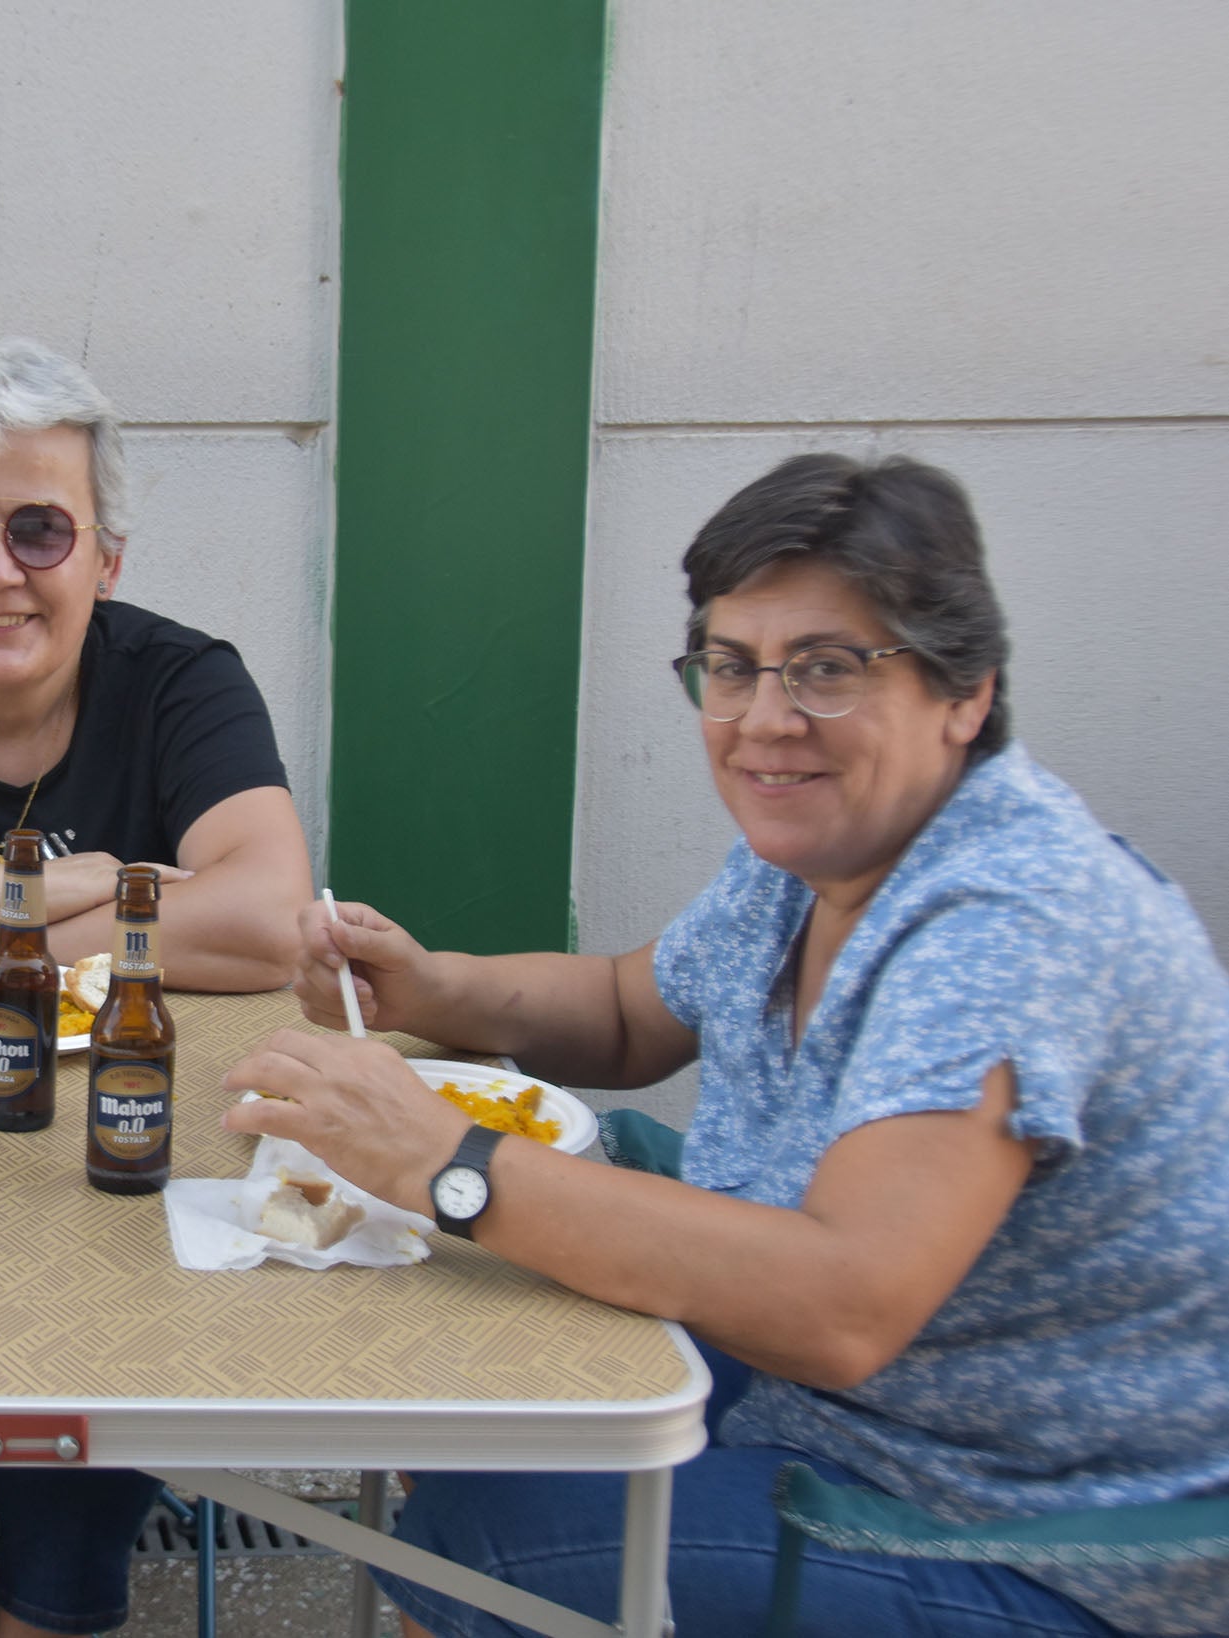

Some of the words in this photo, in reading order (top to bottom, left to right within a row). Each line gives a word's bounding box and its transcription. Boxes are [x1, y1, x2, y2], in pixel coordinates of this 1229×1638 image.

[118, 960, 155, 970] TOSTADA
[100, 1096, 163, 1116] Mahou
[113, 1135, 150, 1144] TOSTADA
